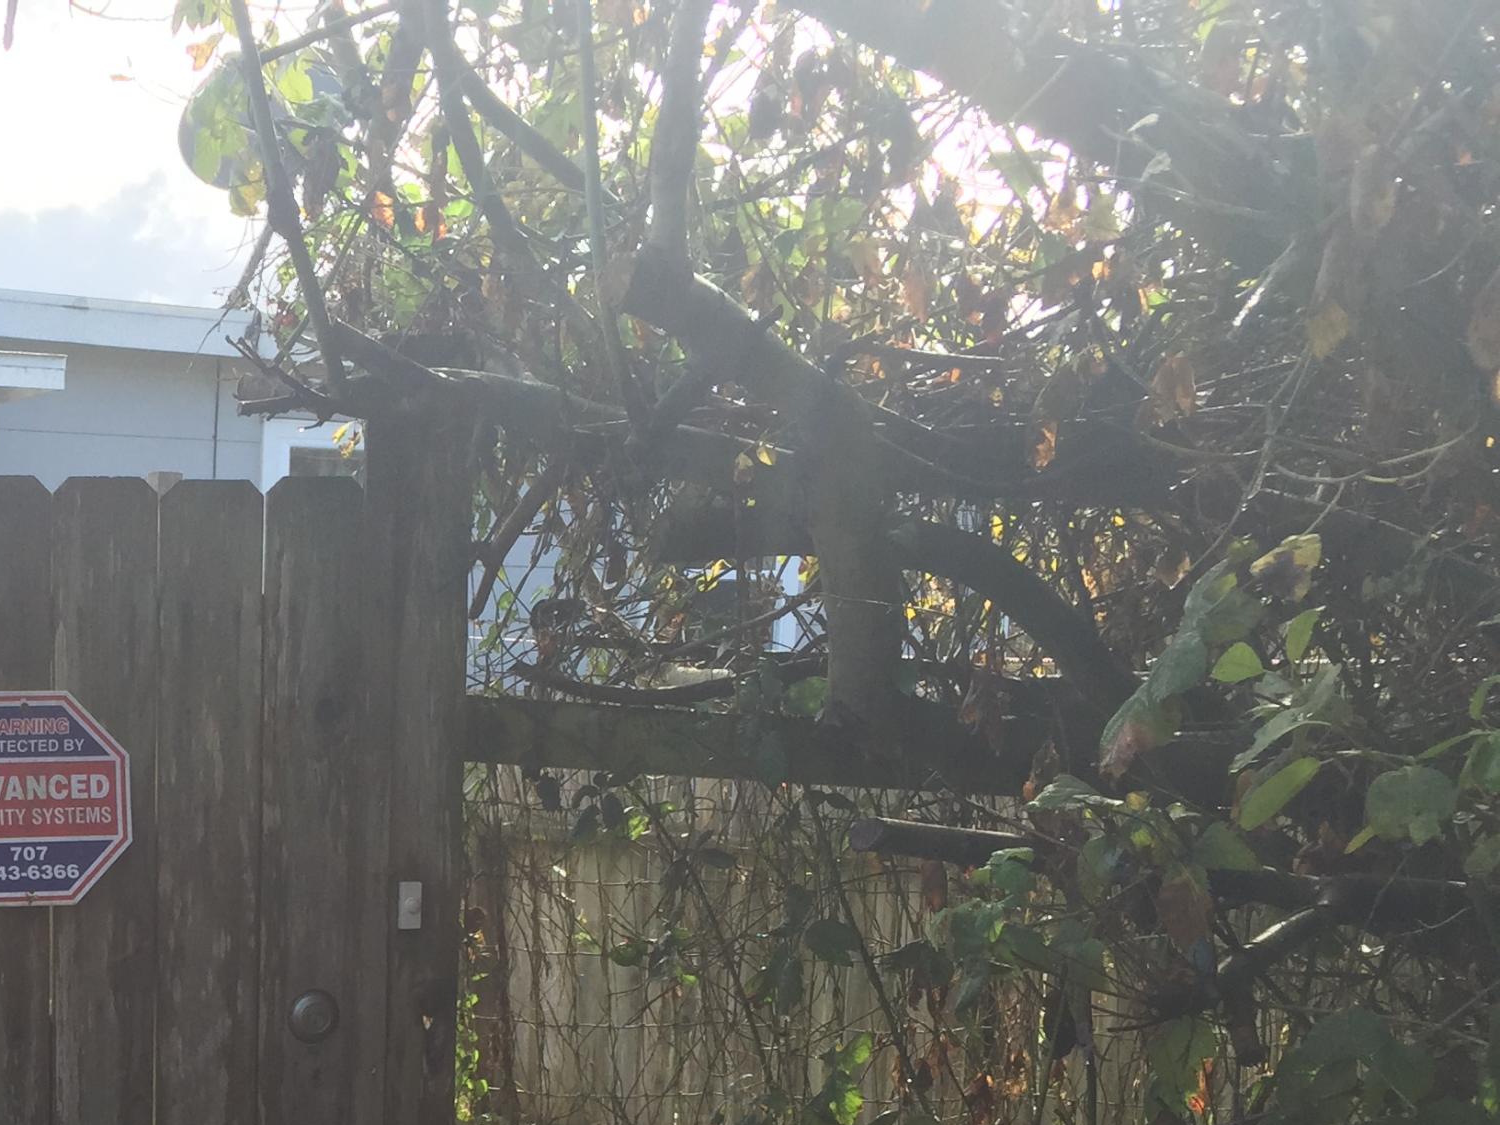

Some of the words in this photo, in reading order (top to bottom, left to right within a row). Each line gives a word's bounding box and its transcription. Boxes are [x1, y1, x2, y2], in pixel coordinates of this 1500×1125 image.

[63, 738, 85, 752] BY
[32, 806, 112, 825] SYSTEMS
[10, 846, 48, 861] 707
